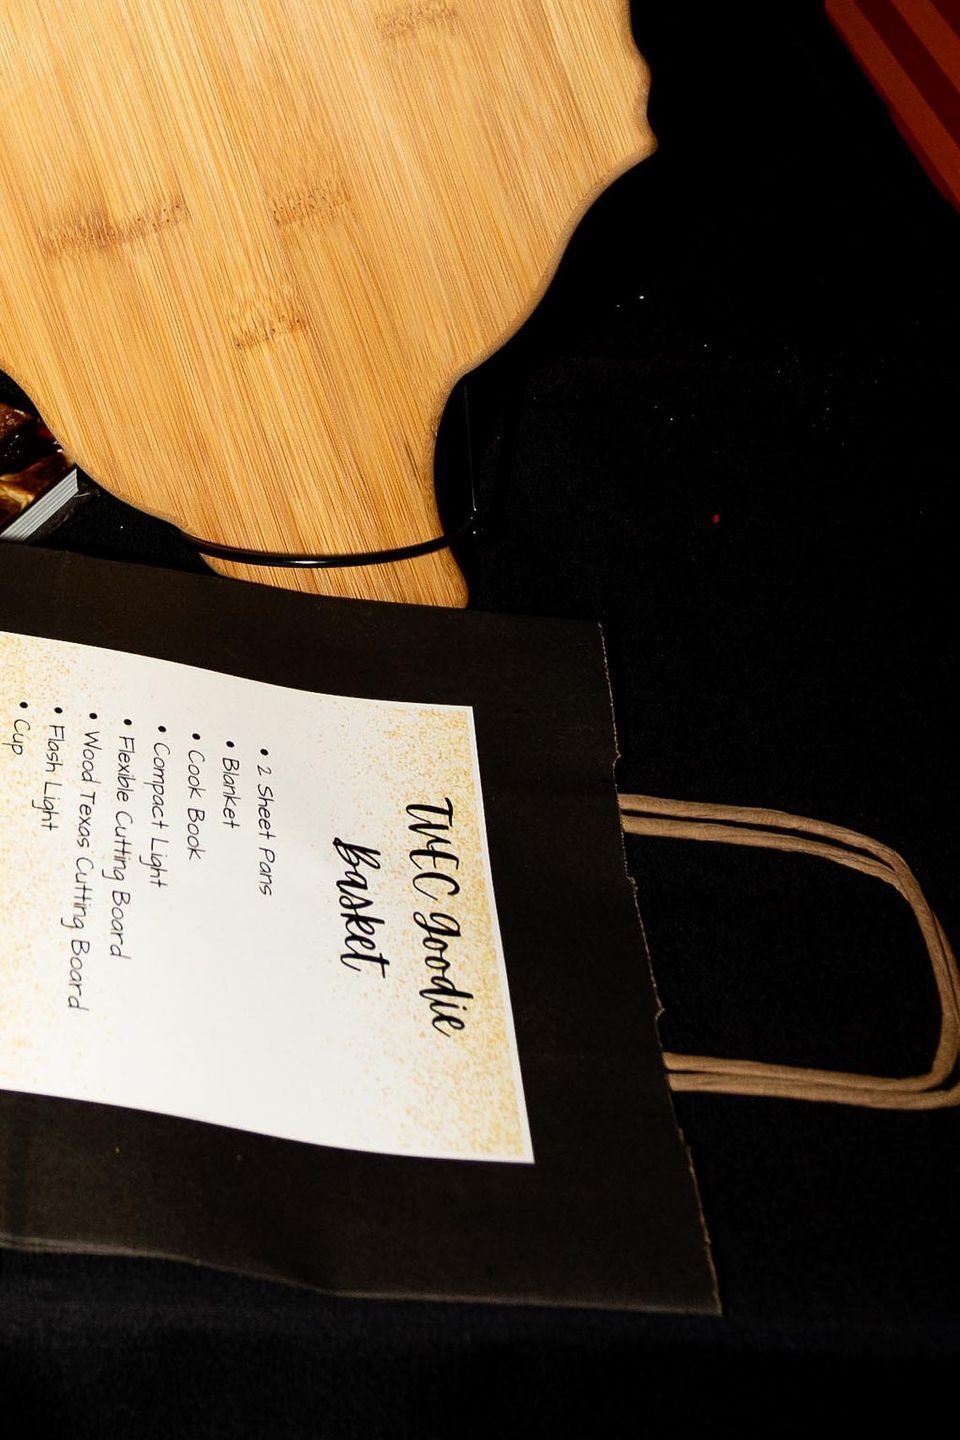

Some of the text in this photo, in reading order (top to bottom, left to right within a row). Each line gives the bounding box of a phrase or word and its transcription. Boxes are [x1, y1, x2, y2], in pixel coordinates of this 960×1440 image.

[2, 719, 31, 756] Cup
[31, 724, 65, 831] Flash Light
[221, 756, 240, 829] Blanket
[102, 735, 136, 960] Flexible Cutting Board
[138, 742, 171, 888] Compact Light
[187, 749, 207, 861] Cook Book
[256, 765, 276, 896] 2 Sheet Pans
[405, 797, 460, 901] TVEC
[60, 730, 103, 1011] Wood Texas Cutting Board
[332, 837, 391, 979] Basket
